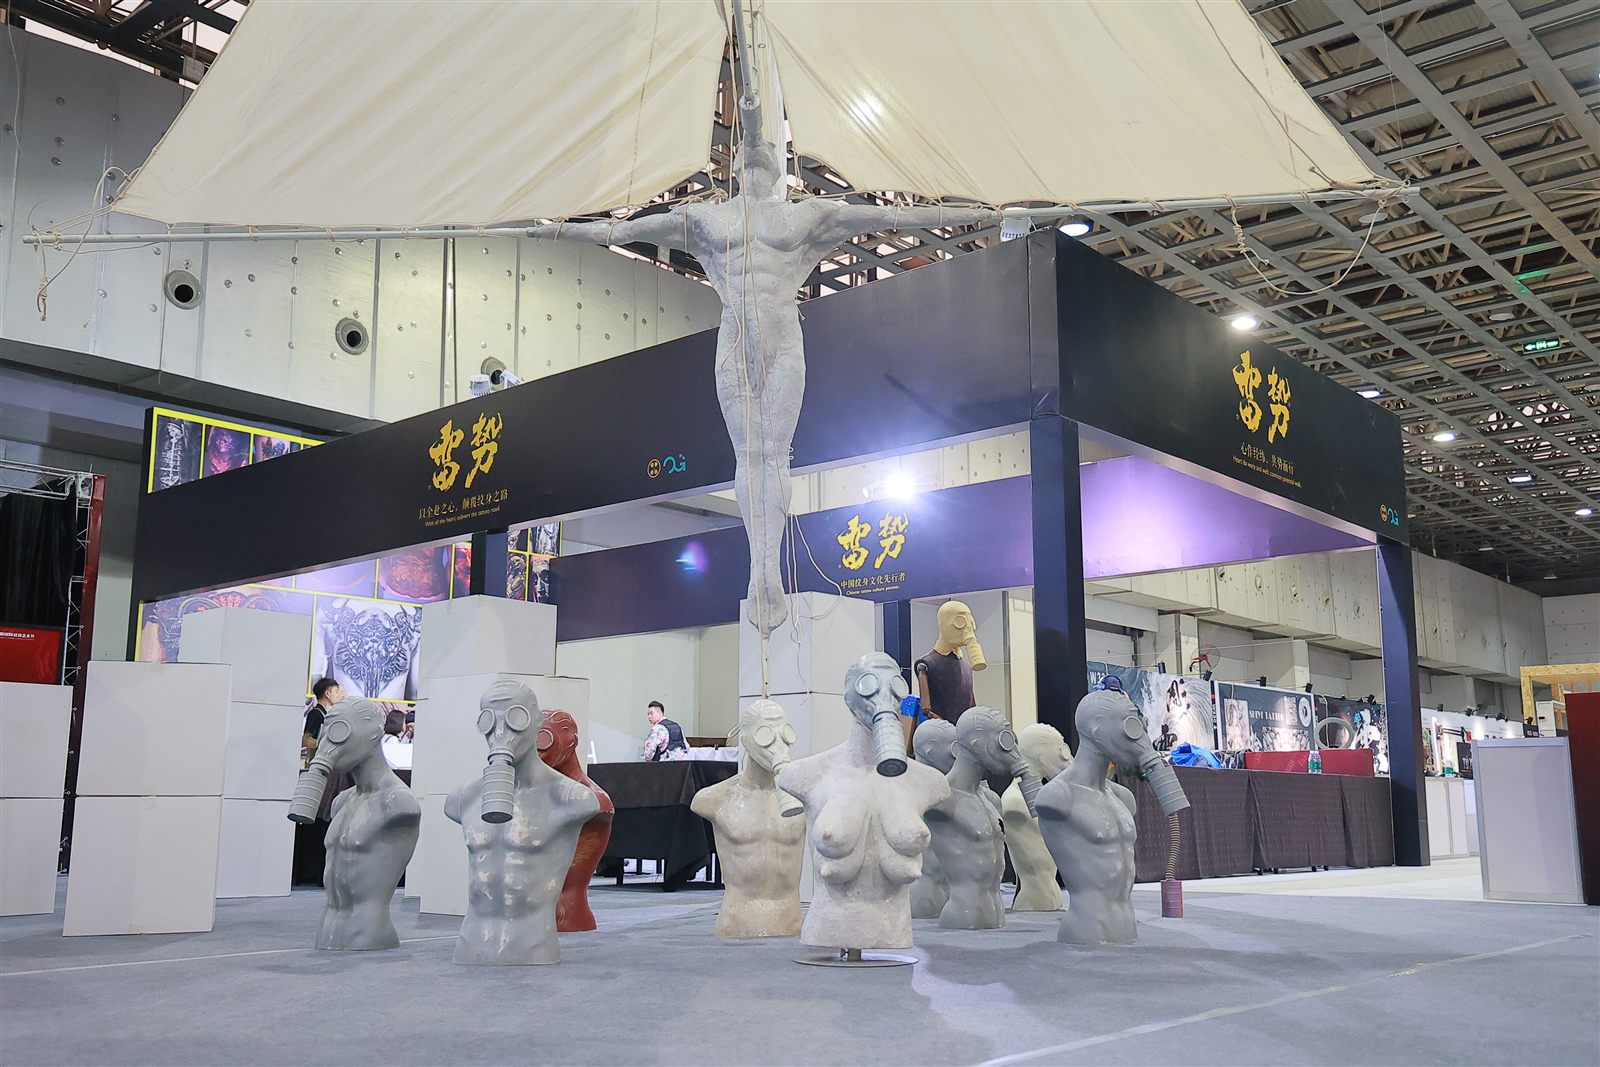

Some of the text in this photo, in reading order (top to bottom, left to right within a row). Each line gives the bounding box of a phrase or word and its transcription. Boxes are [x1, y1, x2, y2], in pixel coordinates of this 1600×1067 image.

[841, 571, 906, 589] 中国纹身文化先行者
